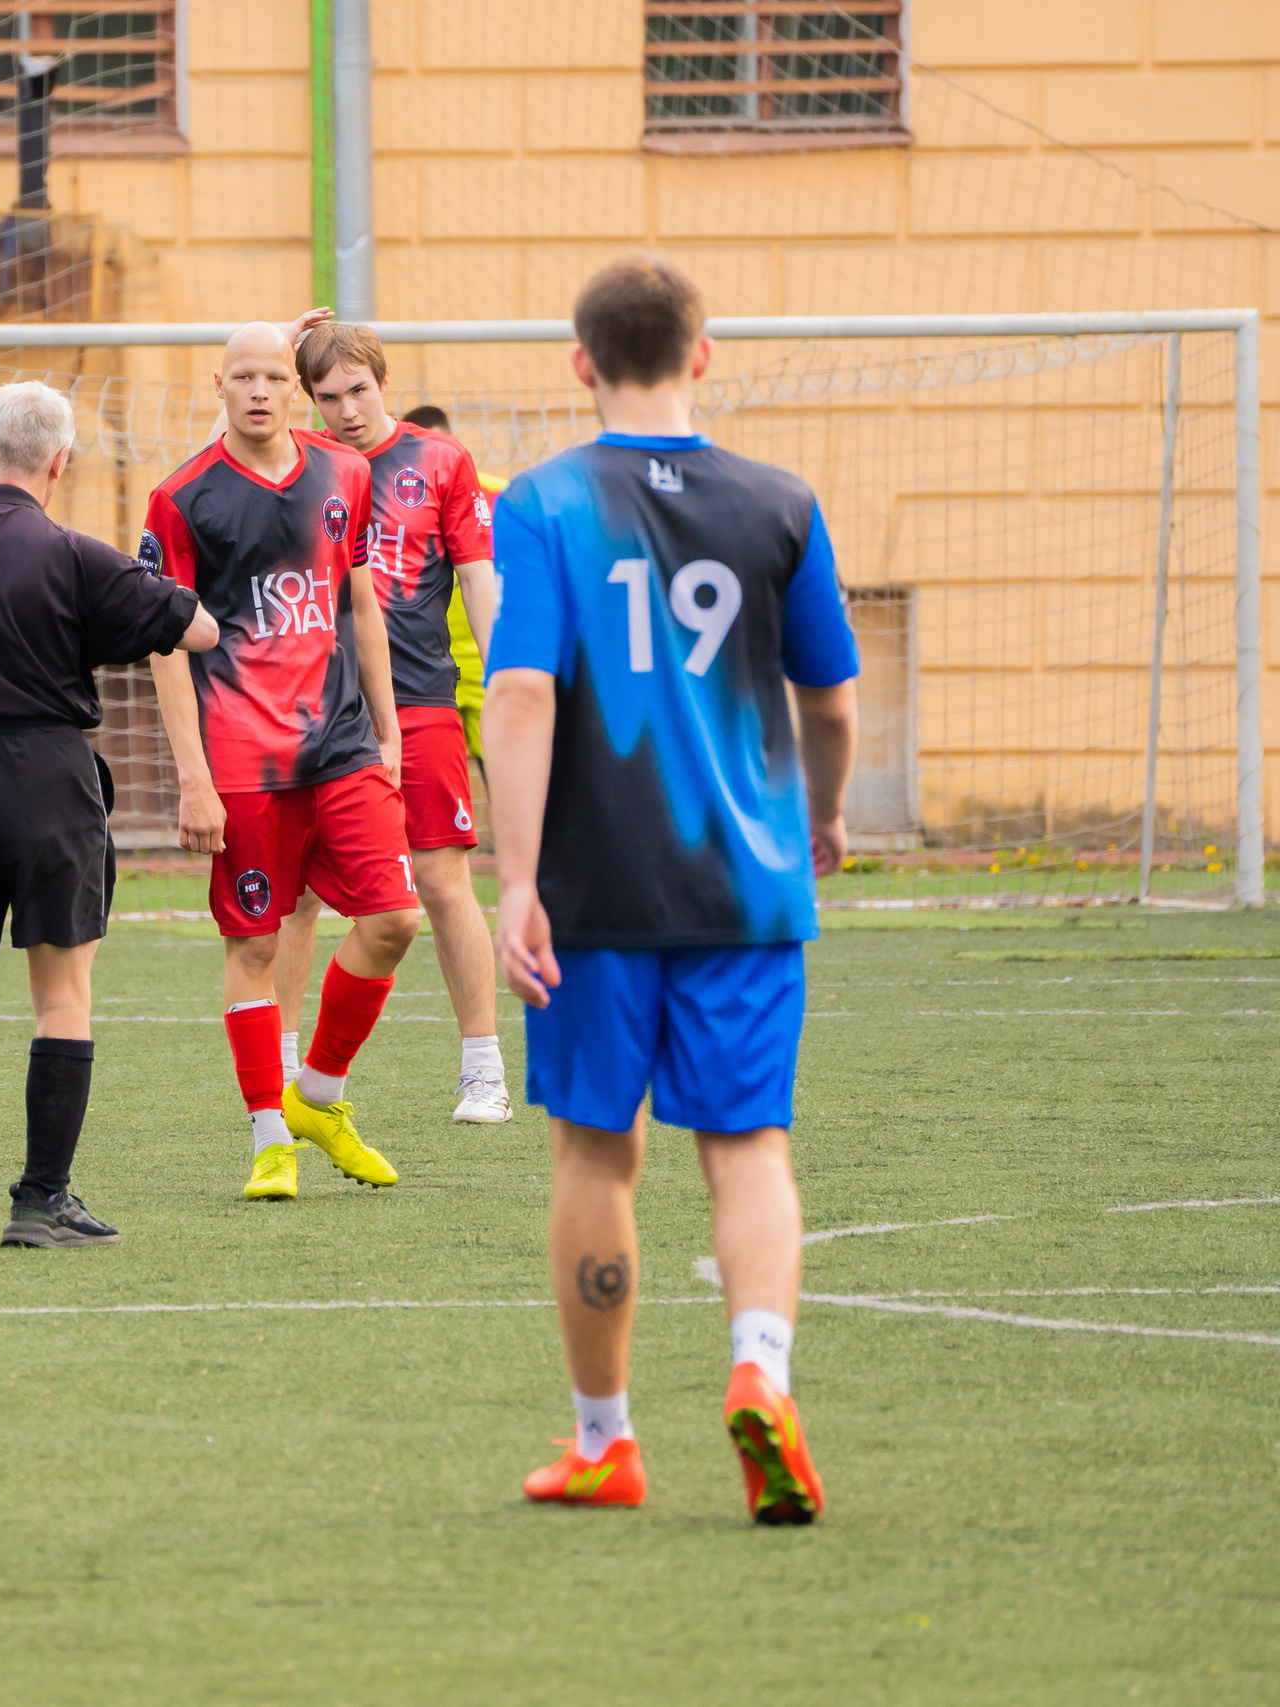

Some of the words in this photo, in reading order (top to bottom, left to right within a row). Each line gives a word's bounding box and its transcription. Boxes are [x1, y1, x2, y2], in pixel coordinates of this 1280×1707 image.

[401, 479, 418, 487] ЮГ
[330, 510, 343, 519] ЮГ
[606, 558, 743, 677] 19
[454, 797, 472, 831] 6
[397, 855, 417, 893] 1
[244, 882, 261, 893] ЮГ
